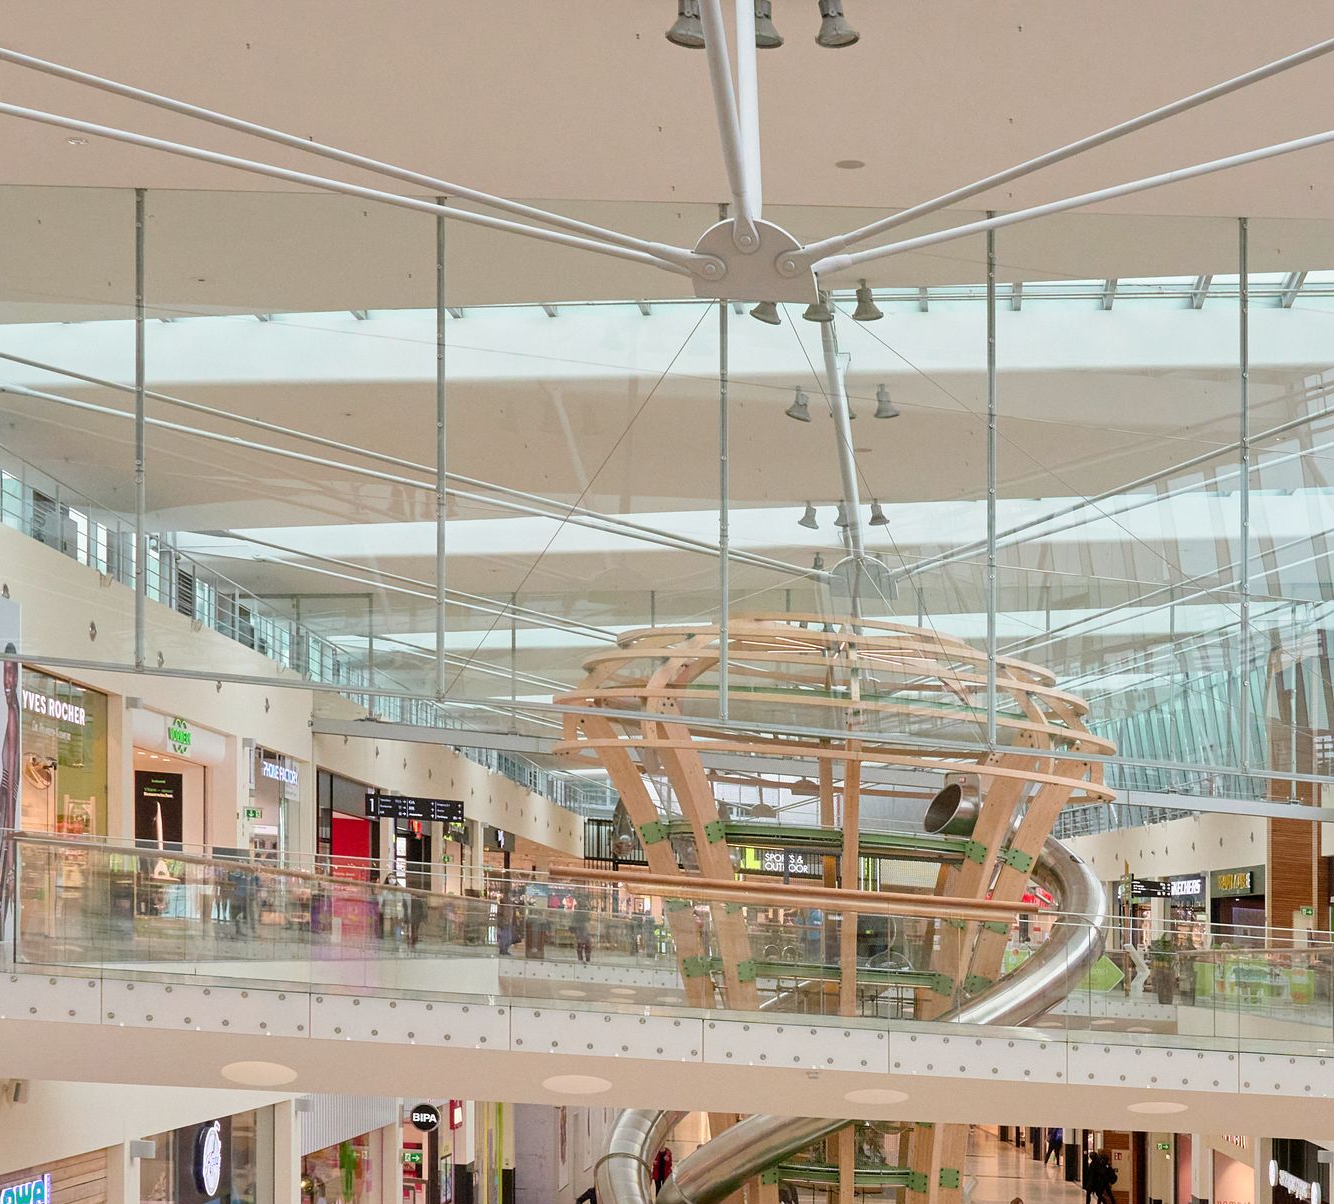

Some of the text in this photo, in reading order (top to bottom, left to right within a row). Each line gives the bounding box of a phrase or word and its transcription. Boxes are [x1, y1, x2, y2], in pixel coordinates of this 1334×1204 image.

[22, 689, 86, 726] YVES ROCHER
[764, 862, 809, 873] OUTOOR
[412, 1112, 437, 1123] BIPA
